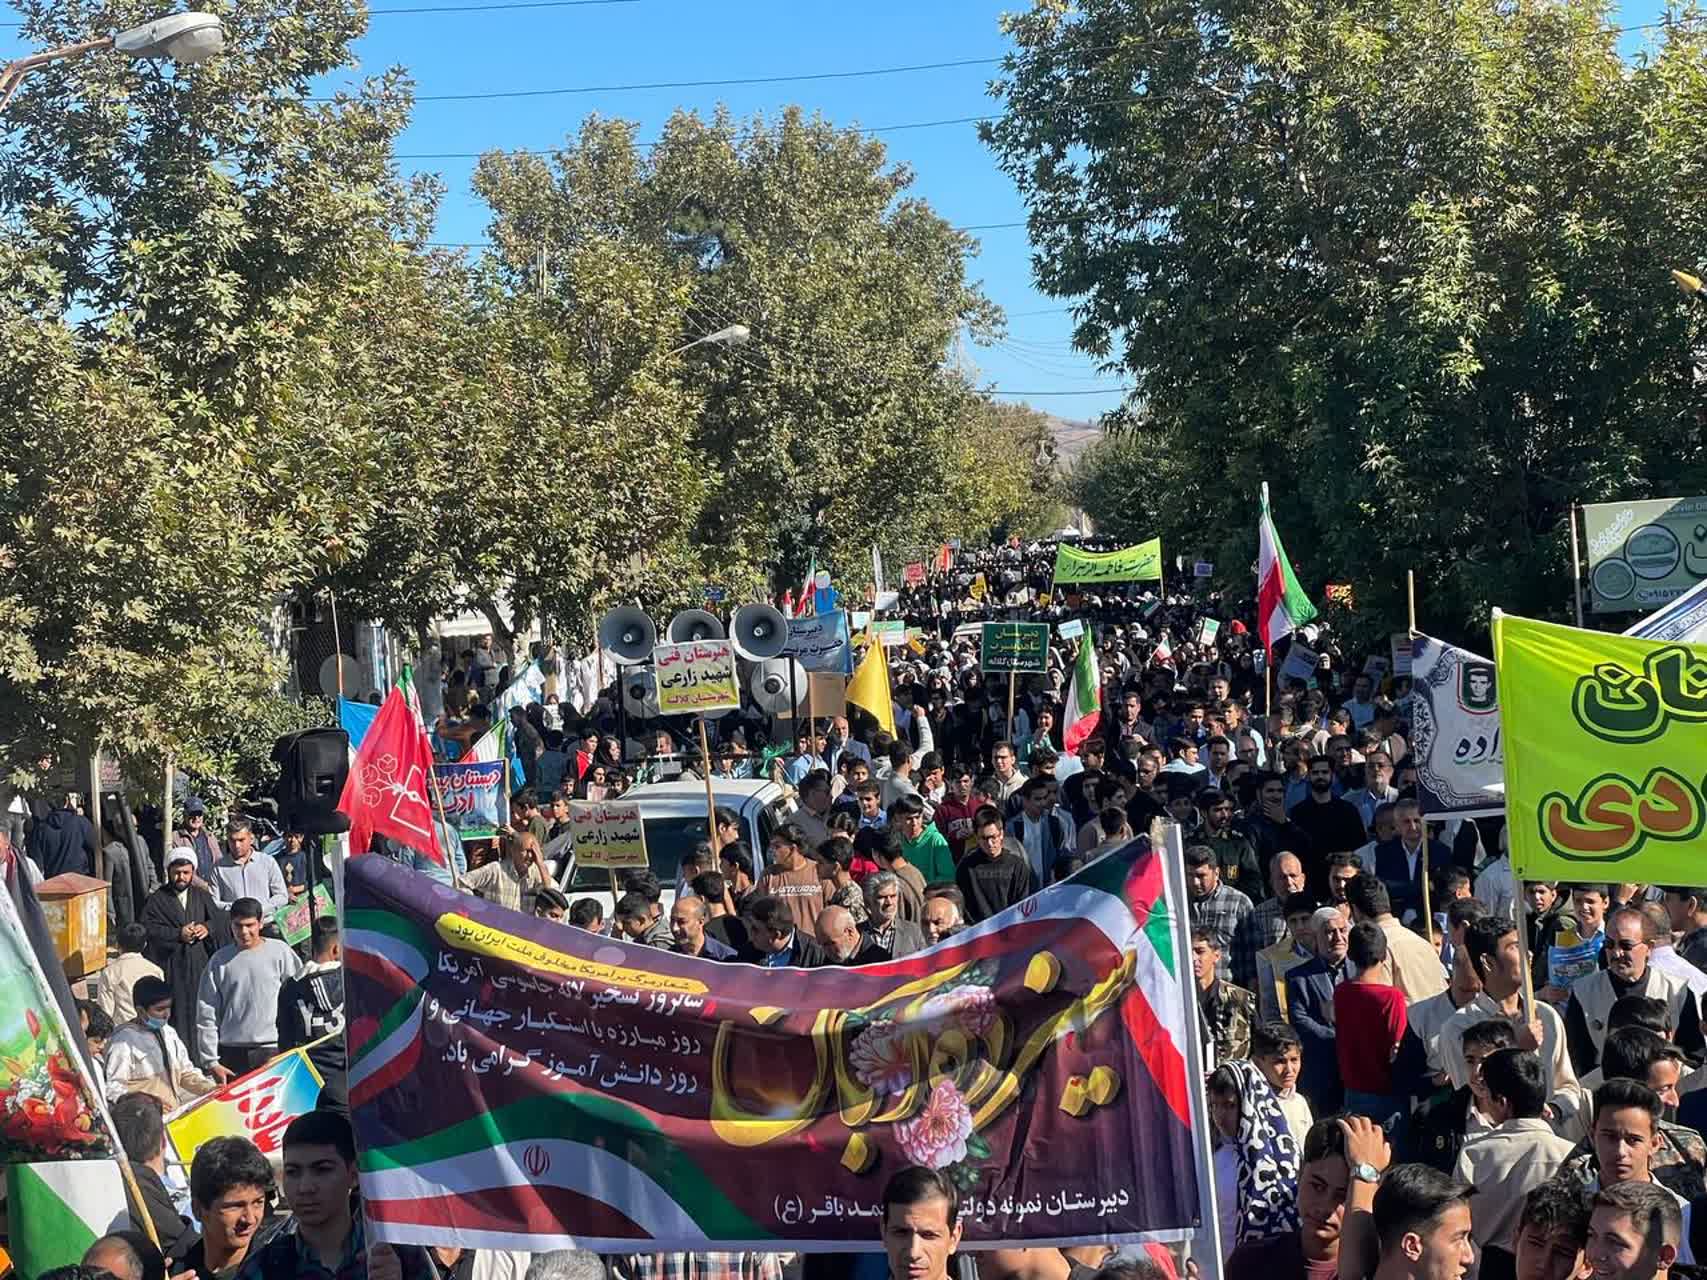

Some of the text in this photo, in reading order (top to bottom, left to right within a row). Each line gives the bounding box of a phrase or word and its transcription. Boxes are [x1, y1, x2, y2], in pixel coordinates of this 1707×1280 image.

[658, 646, 730, 666] هنرستان فنی
[661, 665, 733, 689] شهید زارعی
[574, 807, 640, 825] هنرستان فنی
[576, 827, 640, 847] شهید زارعی
[474, 933, 506, 946] ایران
[437, 950, 484, 984] آمریکا
[491, 974, 553, 999] جاسوسی
[558, 979, 586, 1001] لانه
[590, 986, 641, 1010] تسخیر
[428, 998, 701, 1055] روز مبارزه با استکبار جهانی و
[471, 1045, 543, 1077] گرامی
[541, 1052, 601, 1081] آموز
[600, 1060, 663, 1089] دانش
[664, 1066, 699, 1096] روز
[774, 1194, 804, 1226] (ع)
[807, 1195, 845, 1225] باقر
[999, 1190, 1043, 1224] نمونه
[1046, 1187, 1131, 1217] دبیرستان
